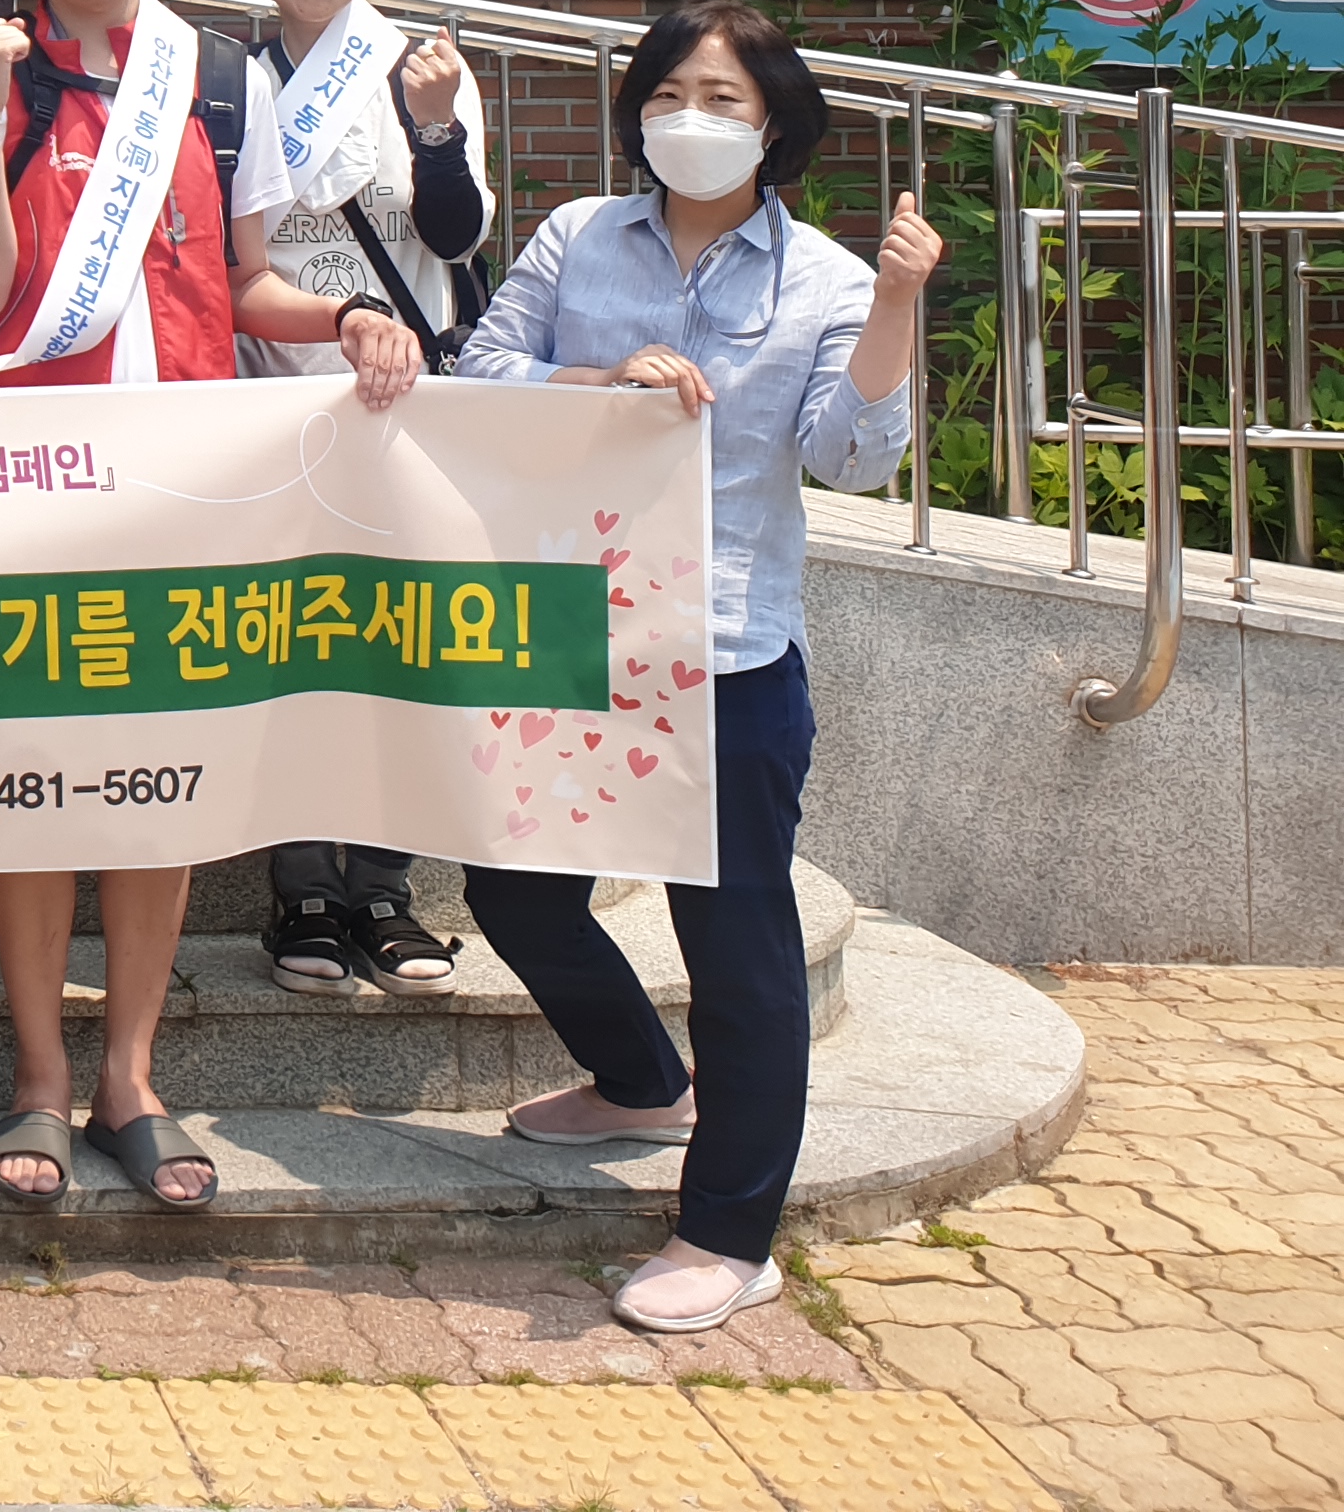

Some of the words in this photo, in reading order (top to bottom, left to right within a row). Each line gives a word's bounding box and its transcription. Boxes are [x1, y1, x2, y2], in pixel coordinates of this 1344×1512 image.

[142, 36, 176, 111] 안산시
[313, 35, 372, 108] 안산시
[311, 254, 357, 271] PARIS
[166, 574, 531, 681] 전해주세요!
